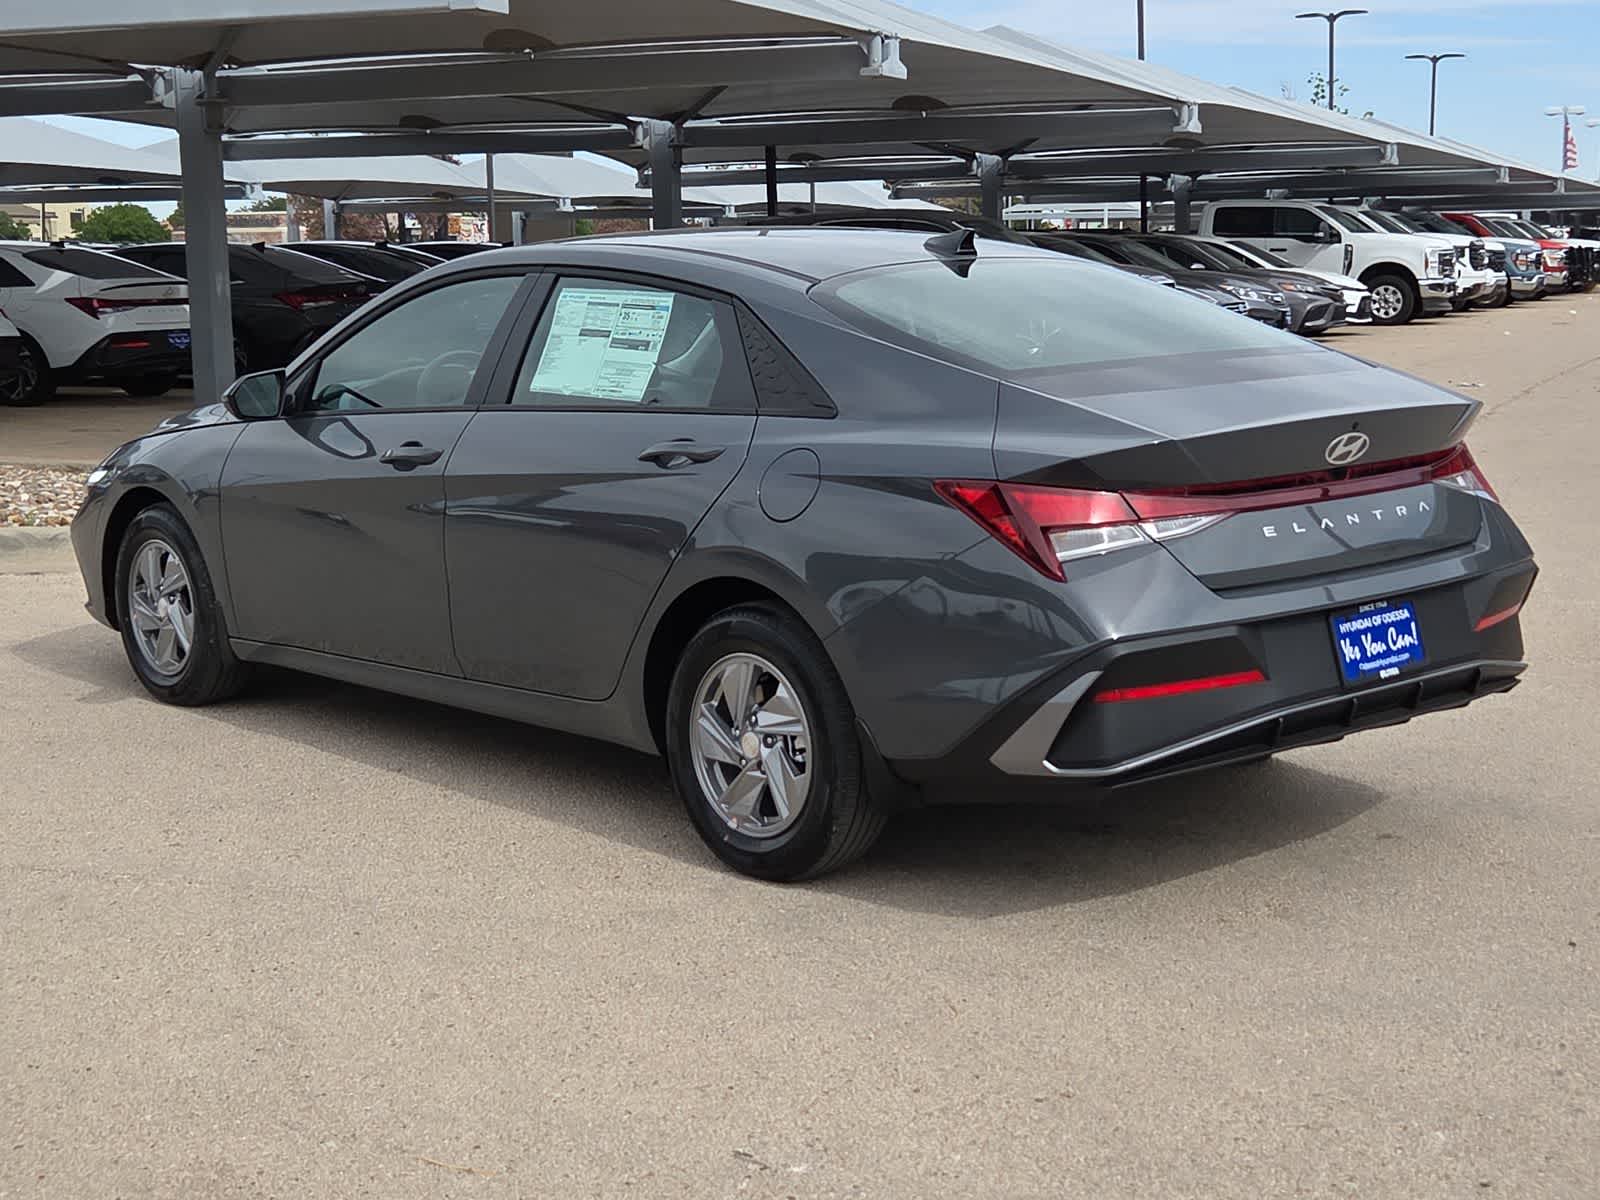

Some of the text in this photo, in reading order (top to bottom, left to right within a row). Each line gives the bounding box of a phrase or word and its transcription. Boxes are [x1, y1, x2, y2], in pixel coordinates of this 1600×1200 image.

[1263, 501, 1430, 537] ELANTRA
[1339, 608, 1410, 634] HYUNDAI OF ODESSA
[1340, 638, 1361, 663] Yes
[1361, 632, 1387, 658] You
[1388, 621, 1419, 651] Can!
